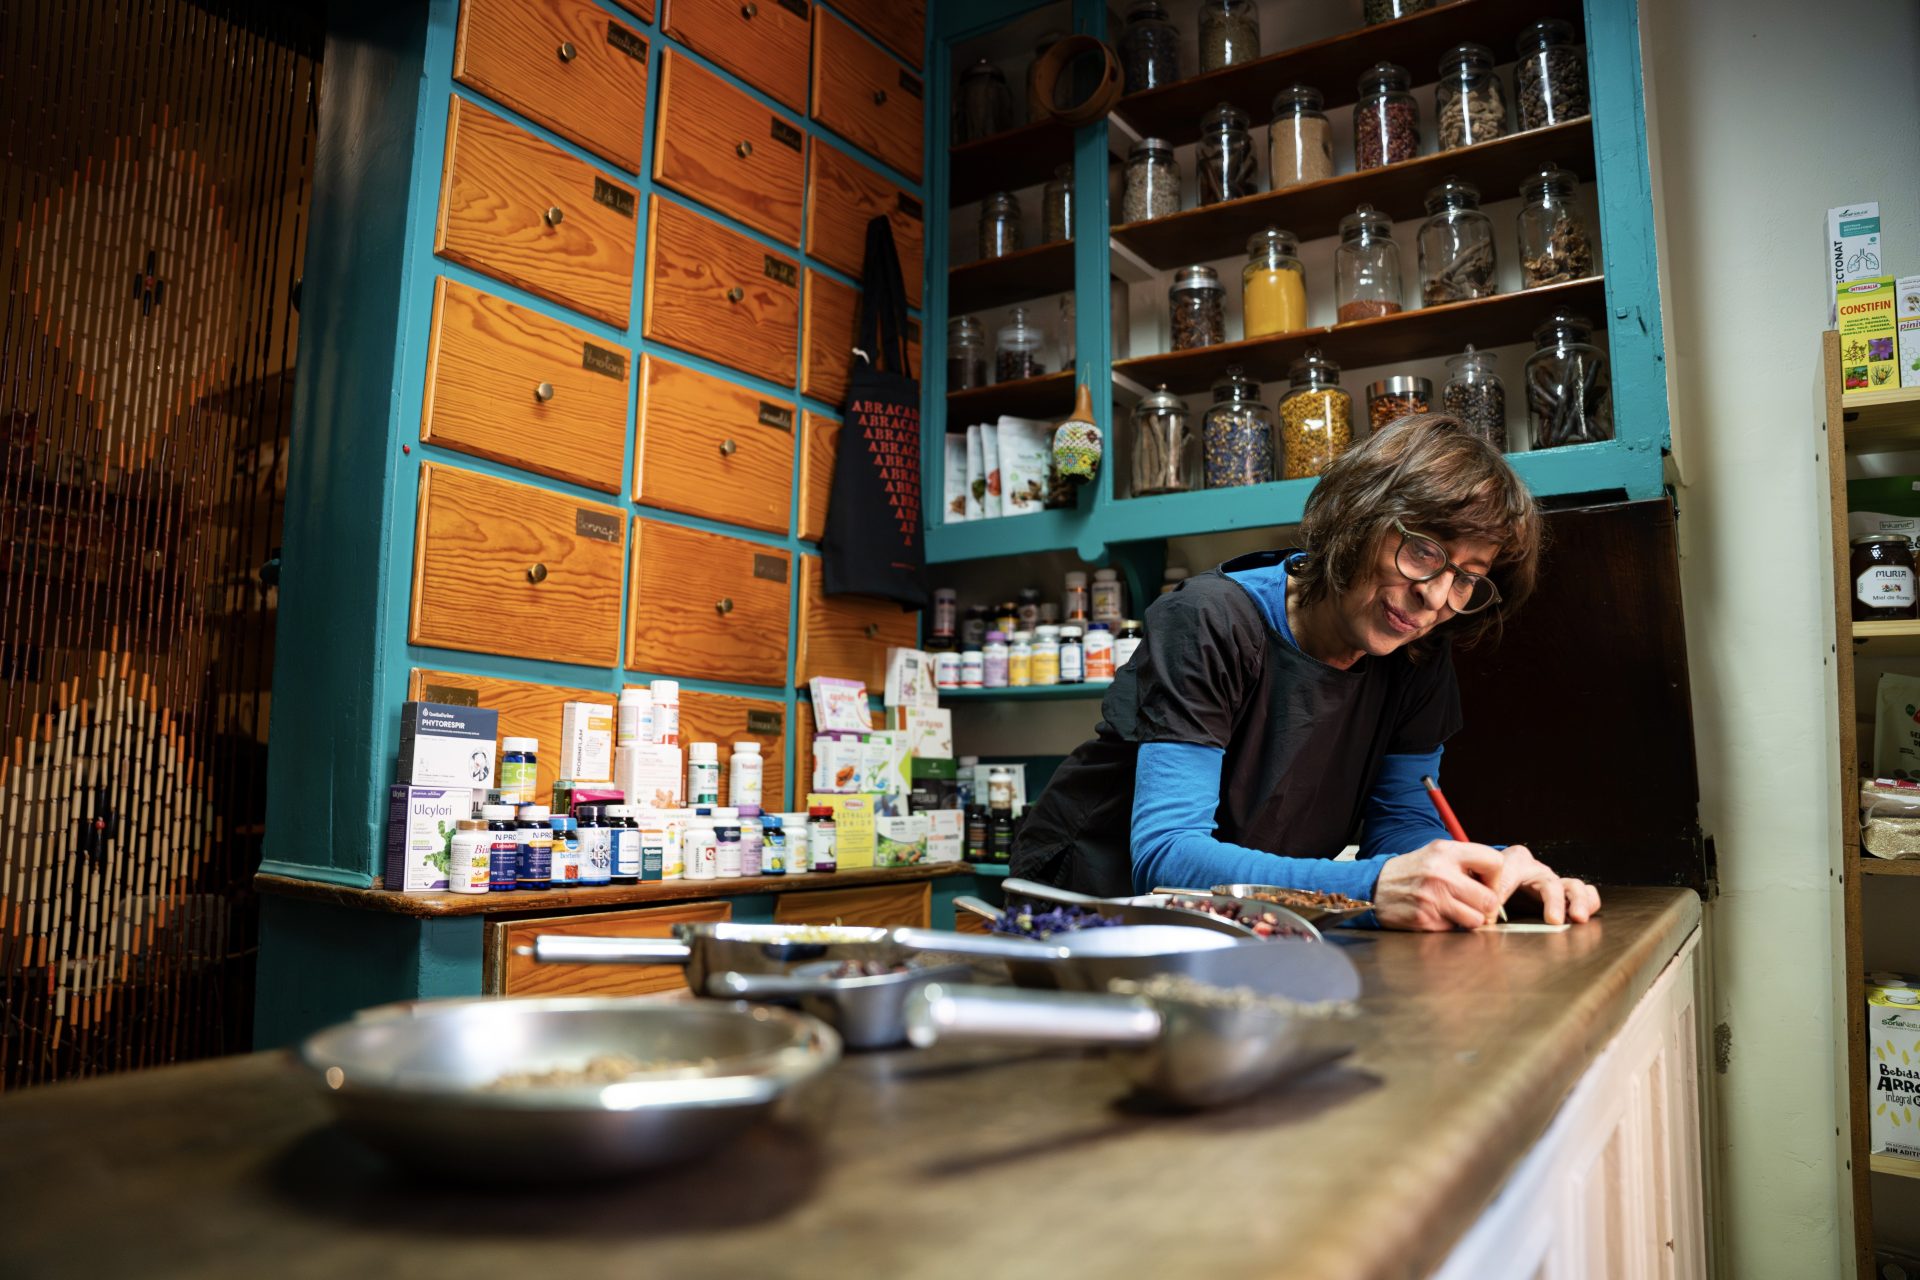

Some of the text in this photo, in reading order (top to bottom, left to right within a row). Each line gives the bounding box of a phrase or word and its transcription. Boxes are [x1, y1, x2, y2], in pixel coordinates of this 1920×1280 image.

[1840, 300, 1891, 315] CONSTIFIN
[903, 535, 913, 546] A
[1875, 570, 1907, 578] MURIA
[421, 719, 465, 730] PHYTORESPIR
[414, 804, 452, 818] Ulcylori
[1879, 1063, 1920, 1080] Bebida
[1885, 1091, 1914, 1107] integral
[1885, 1146, 1898, 1154] SIN
